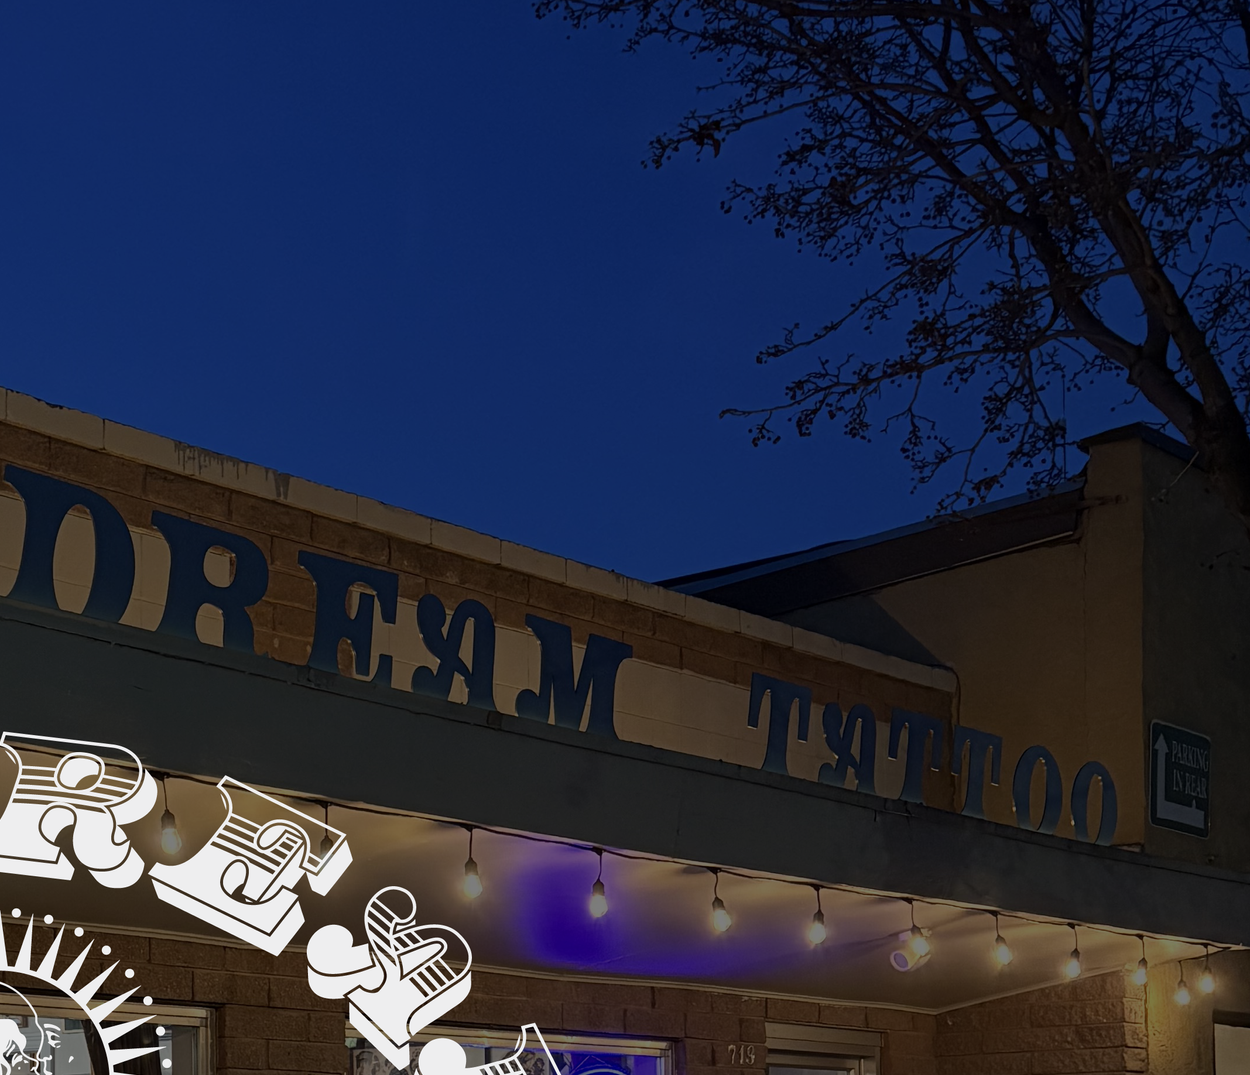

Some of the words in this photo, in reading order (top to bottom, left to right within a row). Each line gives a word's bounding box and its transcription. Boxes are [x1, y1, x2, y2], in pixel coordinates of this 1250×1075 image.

[747, 672, 1118, 847] TATTOO
[1171, 741, 1209, 772] PARKING
[1173, 769, 1184, 792] IN
[1185, 773, 1208, 799] REAR
